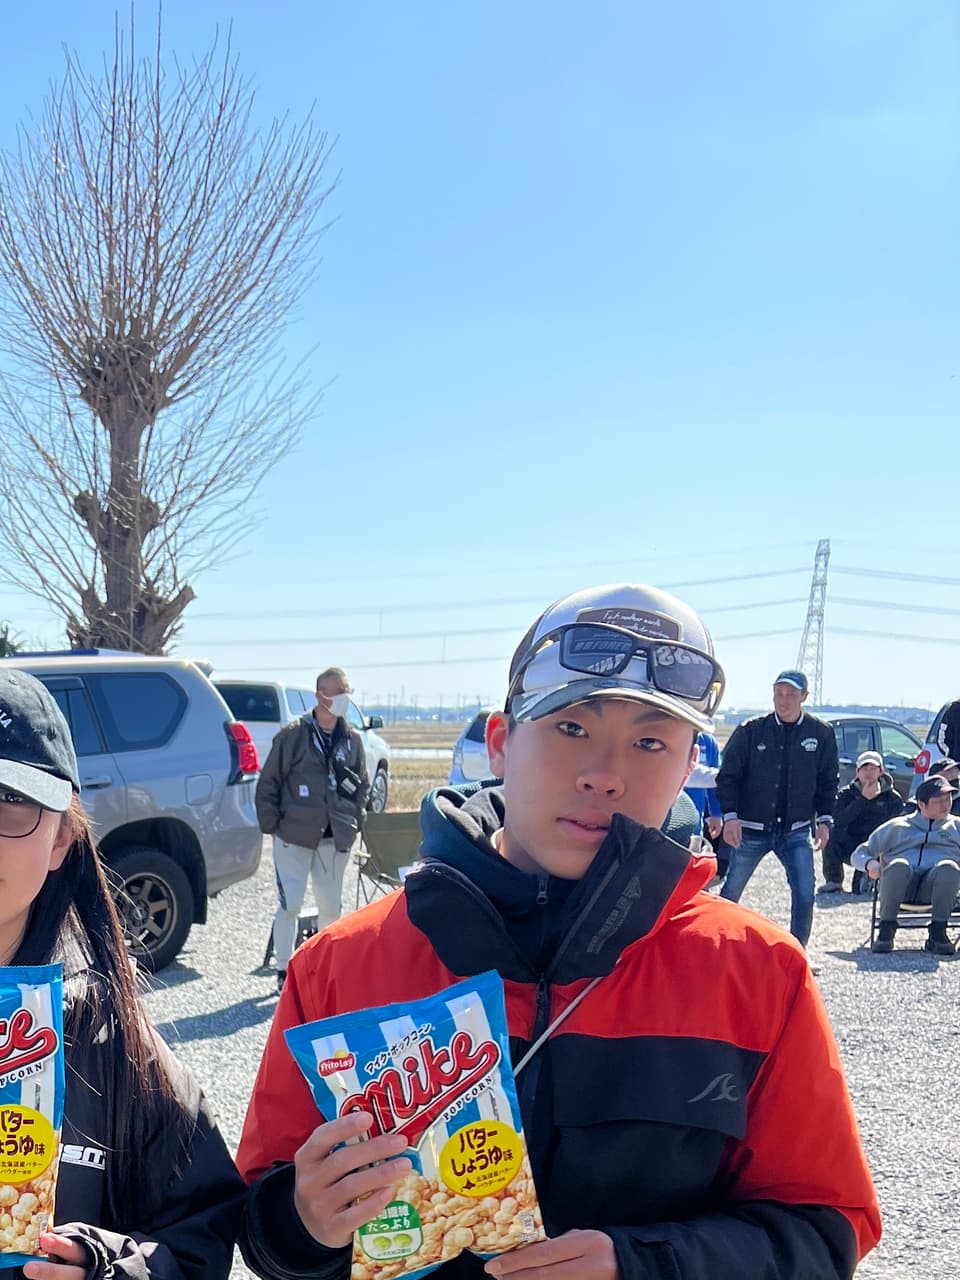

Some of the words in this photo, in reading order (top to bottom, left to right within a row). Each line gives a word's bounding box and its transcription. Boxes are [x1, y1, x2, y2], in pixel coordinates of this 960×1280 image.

[460, 1128, 498, 1153] バター
[451, 1146, 514, 1177] しょうゆ味
[368, 1217, 410, 1232] たっぷり
